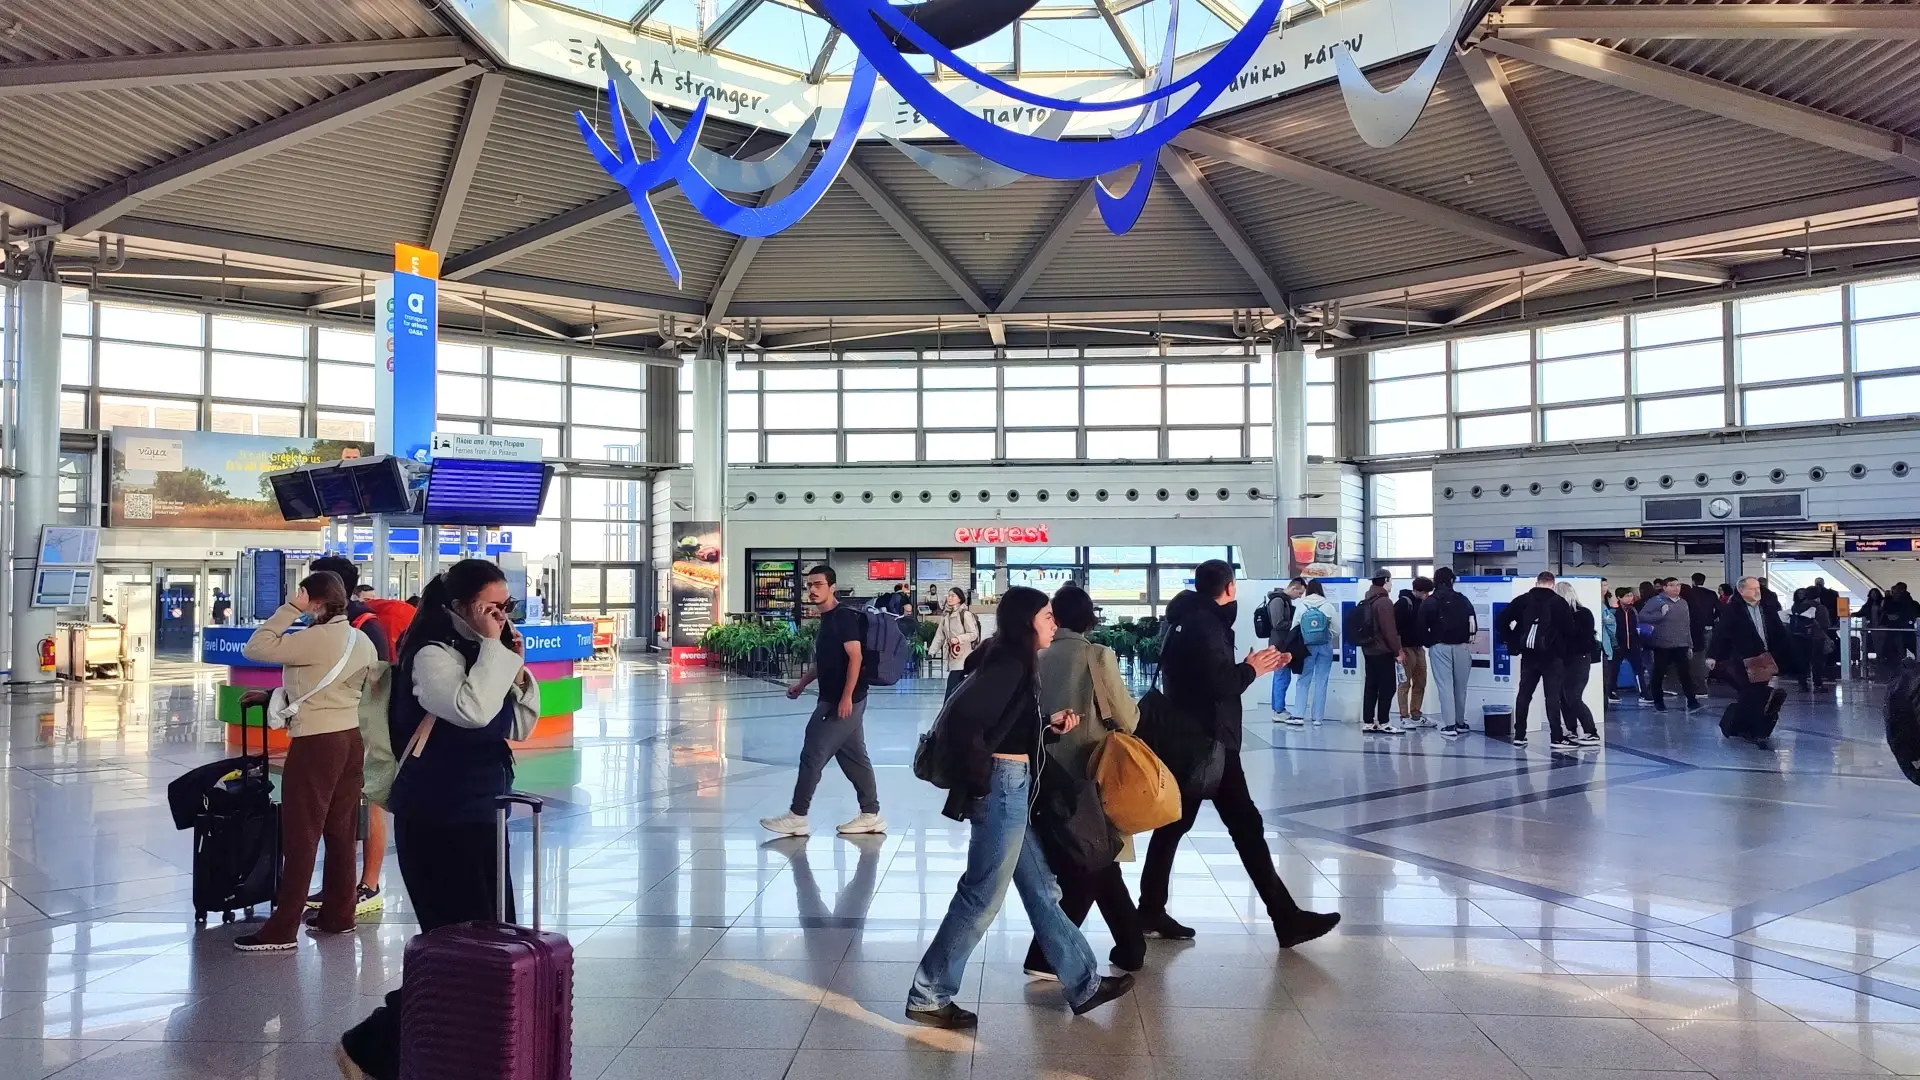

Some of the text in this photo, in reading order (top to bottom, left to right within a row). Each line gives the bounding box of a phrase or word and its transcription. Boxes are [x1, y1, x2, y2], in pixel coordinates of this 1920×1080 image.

[650, 59, 770, 115] A stranger.
[403, 319, 429, 331] for athens
[404, 314, 428, 324] transport
[408, 328, 424, 337] OASA
[270, 451, 298, 463] Greek
[299, 454, 308, 463] to
[310, 456, 321, 464] us
[455, 447, 474, 455] Ferries
[474, 447, 487, 455] from
[498, 449, 518, 457] Piraeus
[954, 523, 1049, 544] everest
[525, 635, 561, 649] Direct
